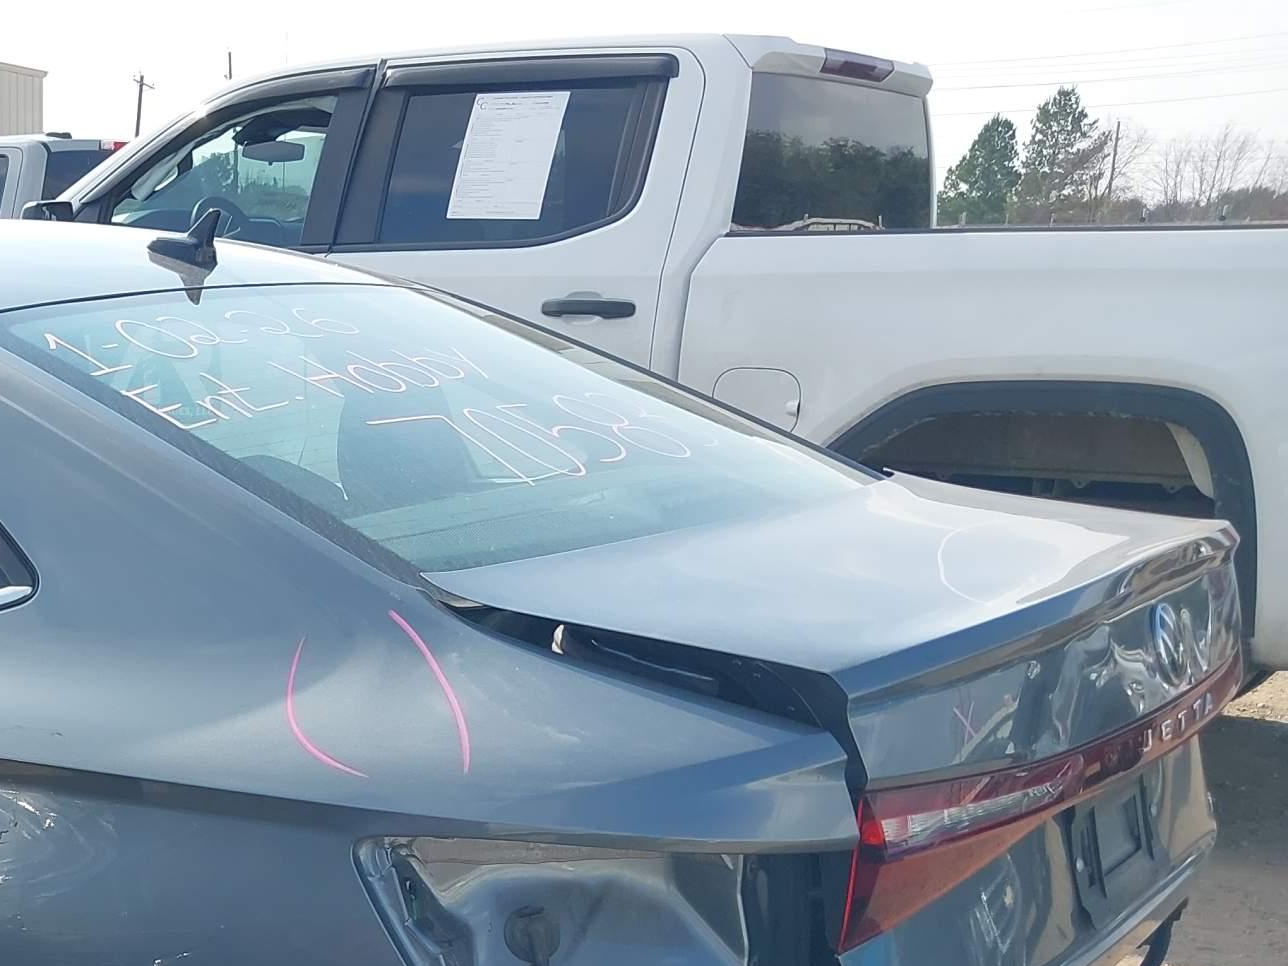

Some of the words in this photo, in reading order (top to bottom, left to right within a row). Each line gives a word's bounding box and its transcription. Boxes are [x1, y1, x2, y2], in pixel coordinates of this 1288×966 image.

[43, 307, 360, 377] 1-02-26
[266, 346, 489, 398] Hobby
[1142, 692, 1213, 753] JETTA
